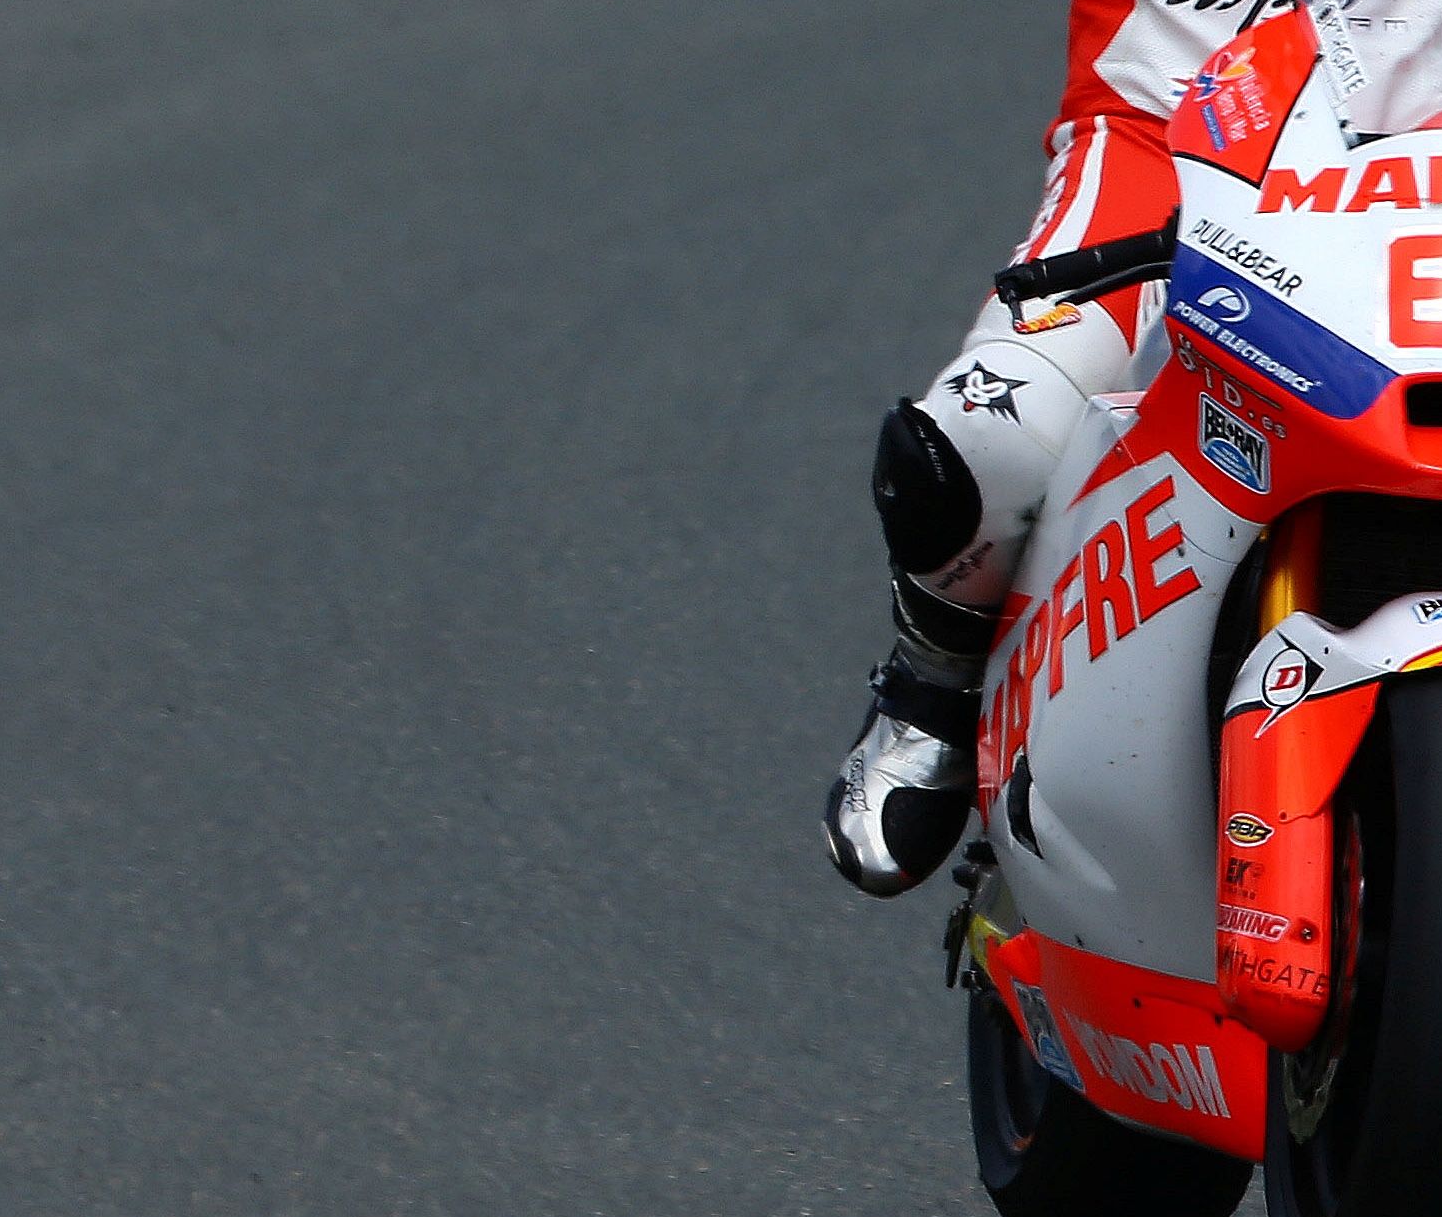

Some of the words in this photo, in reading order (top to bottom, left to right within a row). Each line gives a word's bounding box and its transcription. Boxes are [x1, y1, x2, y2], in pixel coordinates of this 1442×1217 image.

[1191, 218, 1303, 298] PULL&BEAR
[1172, 300, 1220, 336] POWER
[1216, 329, 1316, 393] ELECTRONICS
